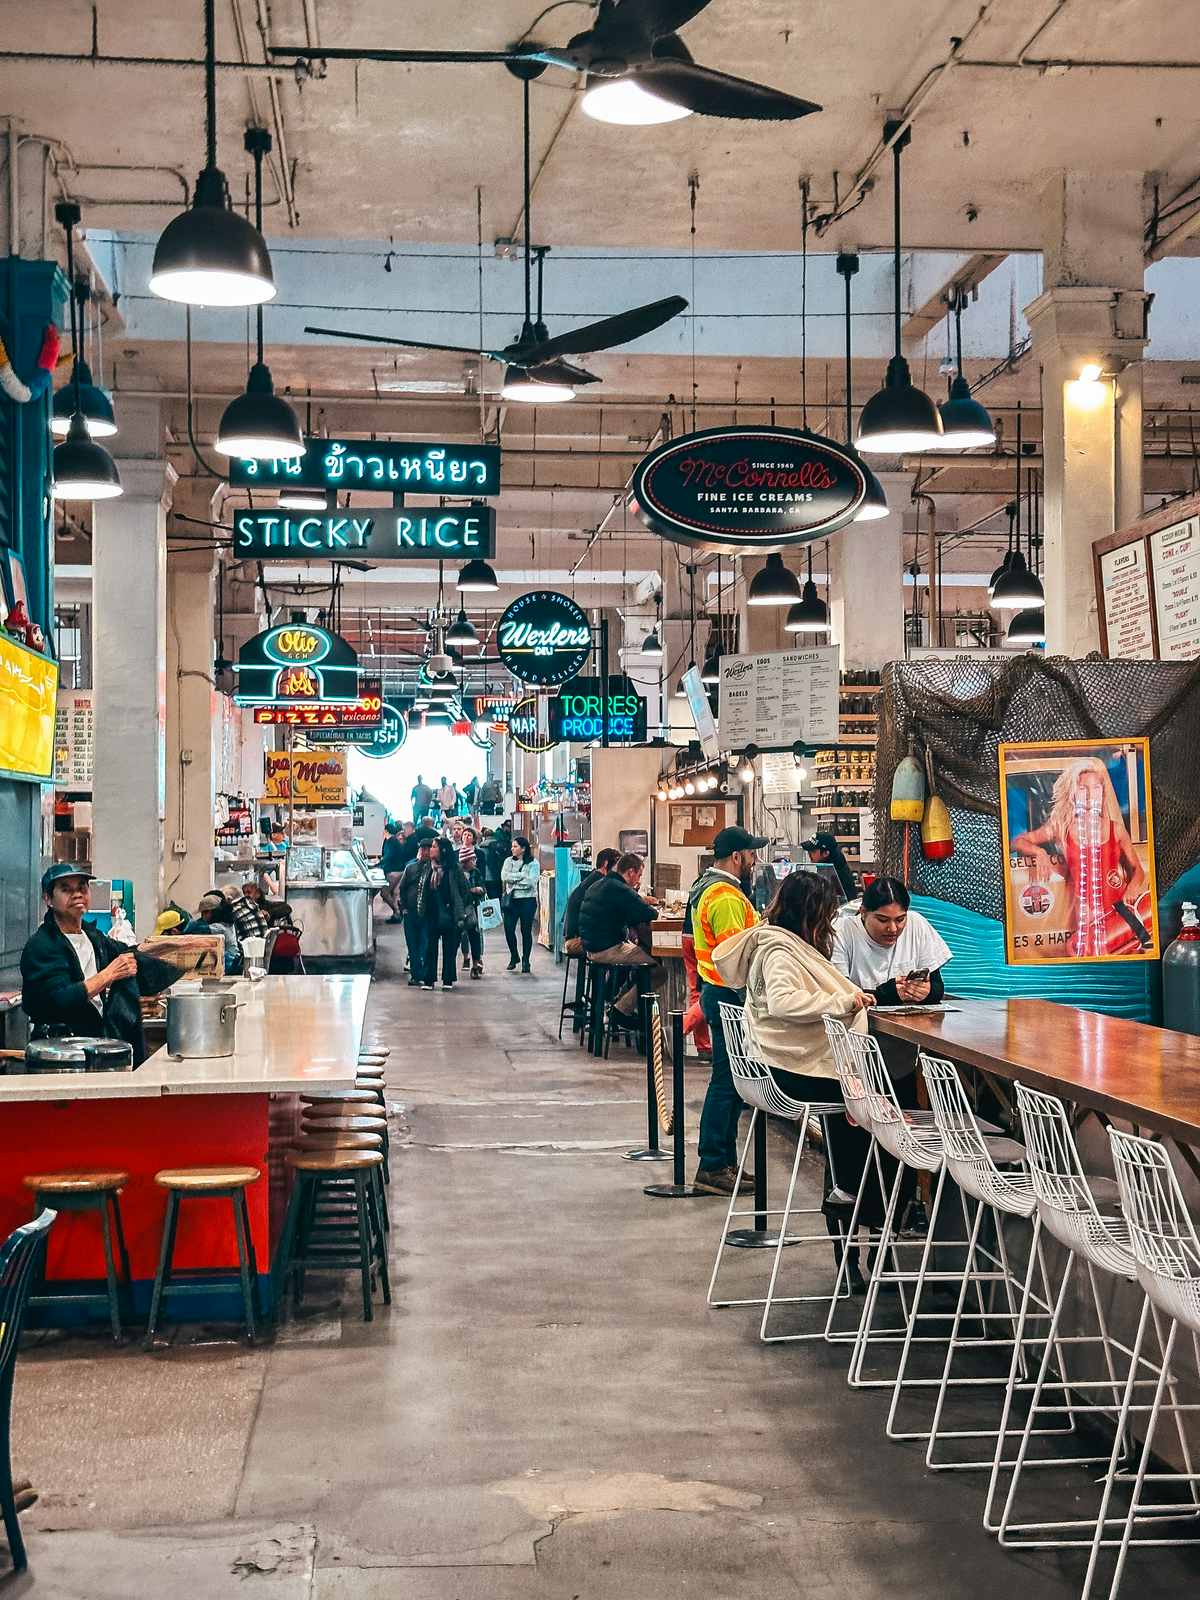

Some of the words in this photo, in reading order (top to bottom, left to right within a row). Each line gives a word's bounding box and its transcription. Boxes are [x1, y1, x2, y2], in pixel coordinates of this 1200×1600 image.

[325, 443, 488, 484] ข้าวเหนียว
[679, 457, 838, 489] McConnell's
[697, 492, 727, 502] FINE
[732, 492, 755, 502] ICE
[759, 492, 813, 502] CREAMS
[709, 506, 740, 514] SANTA
[742, 506, 786, 514] BARBARA,
[788, 506, 801, 514] CA
[239, 517, 371, 547] STICKY
[396, 517, 480, 547] RICE
[507, 595, 537, 619] HOUSE
[550, 594, 582, 621] SMOKED
[278, 631, 318, 653] Olio
[499, 620, 591, 647] Wexler's
[505, 655, 538, 681] HAND
[551, 655, 583, 681] SLICED
[782, 653, 820, 662] SANDWICHES
[560, 695, 638, 716] TORRES
[258, 712, 337, 724] PIZZA
[293, 760, 344, 783] Maria
[315, 785, 344, 793] Mexican
[1014, 935, 1029, 948] ES
[1034, 934, 1044, 946] &
[1048, 931, 1073, 945] HAP
